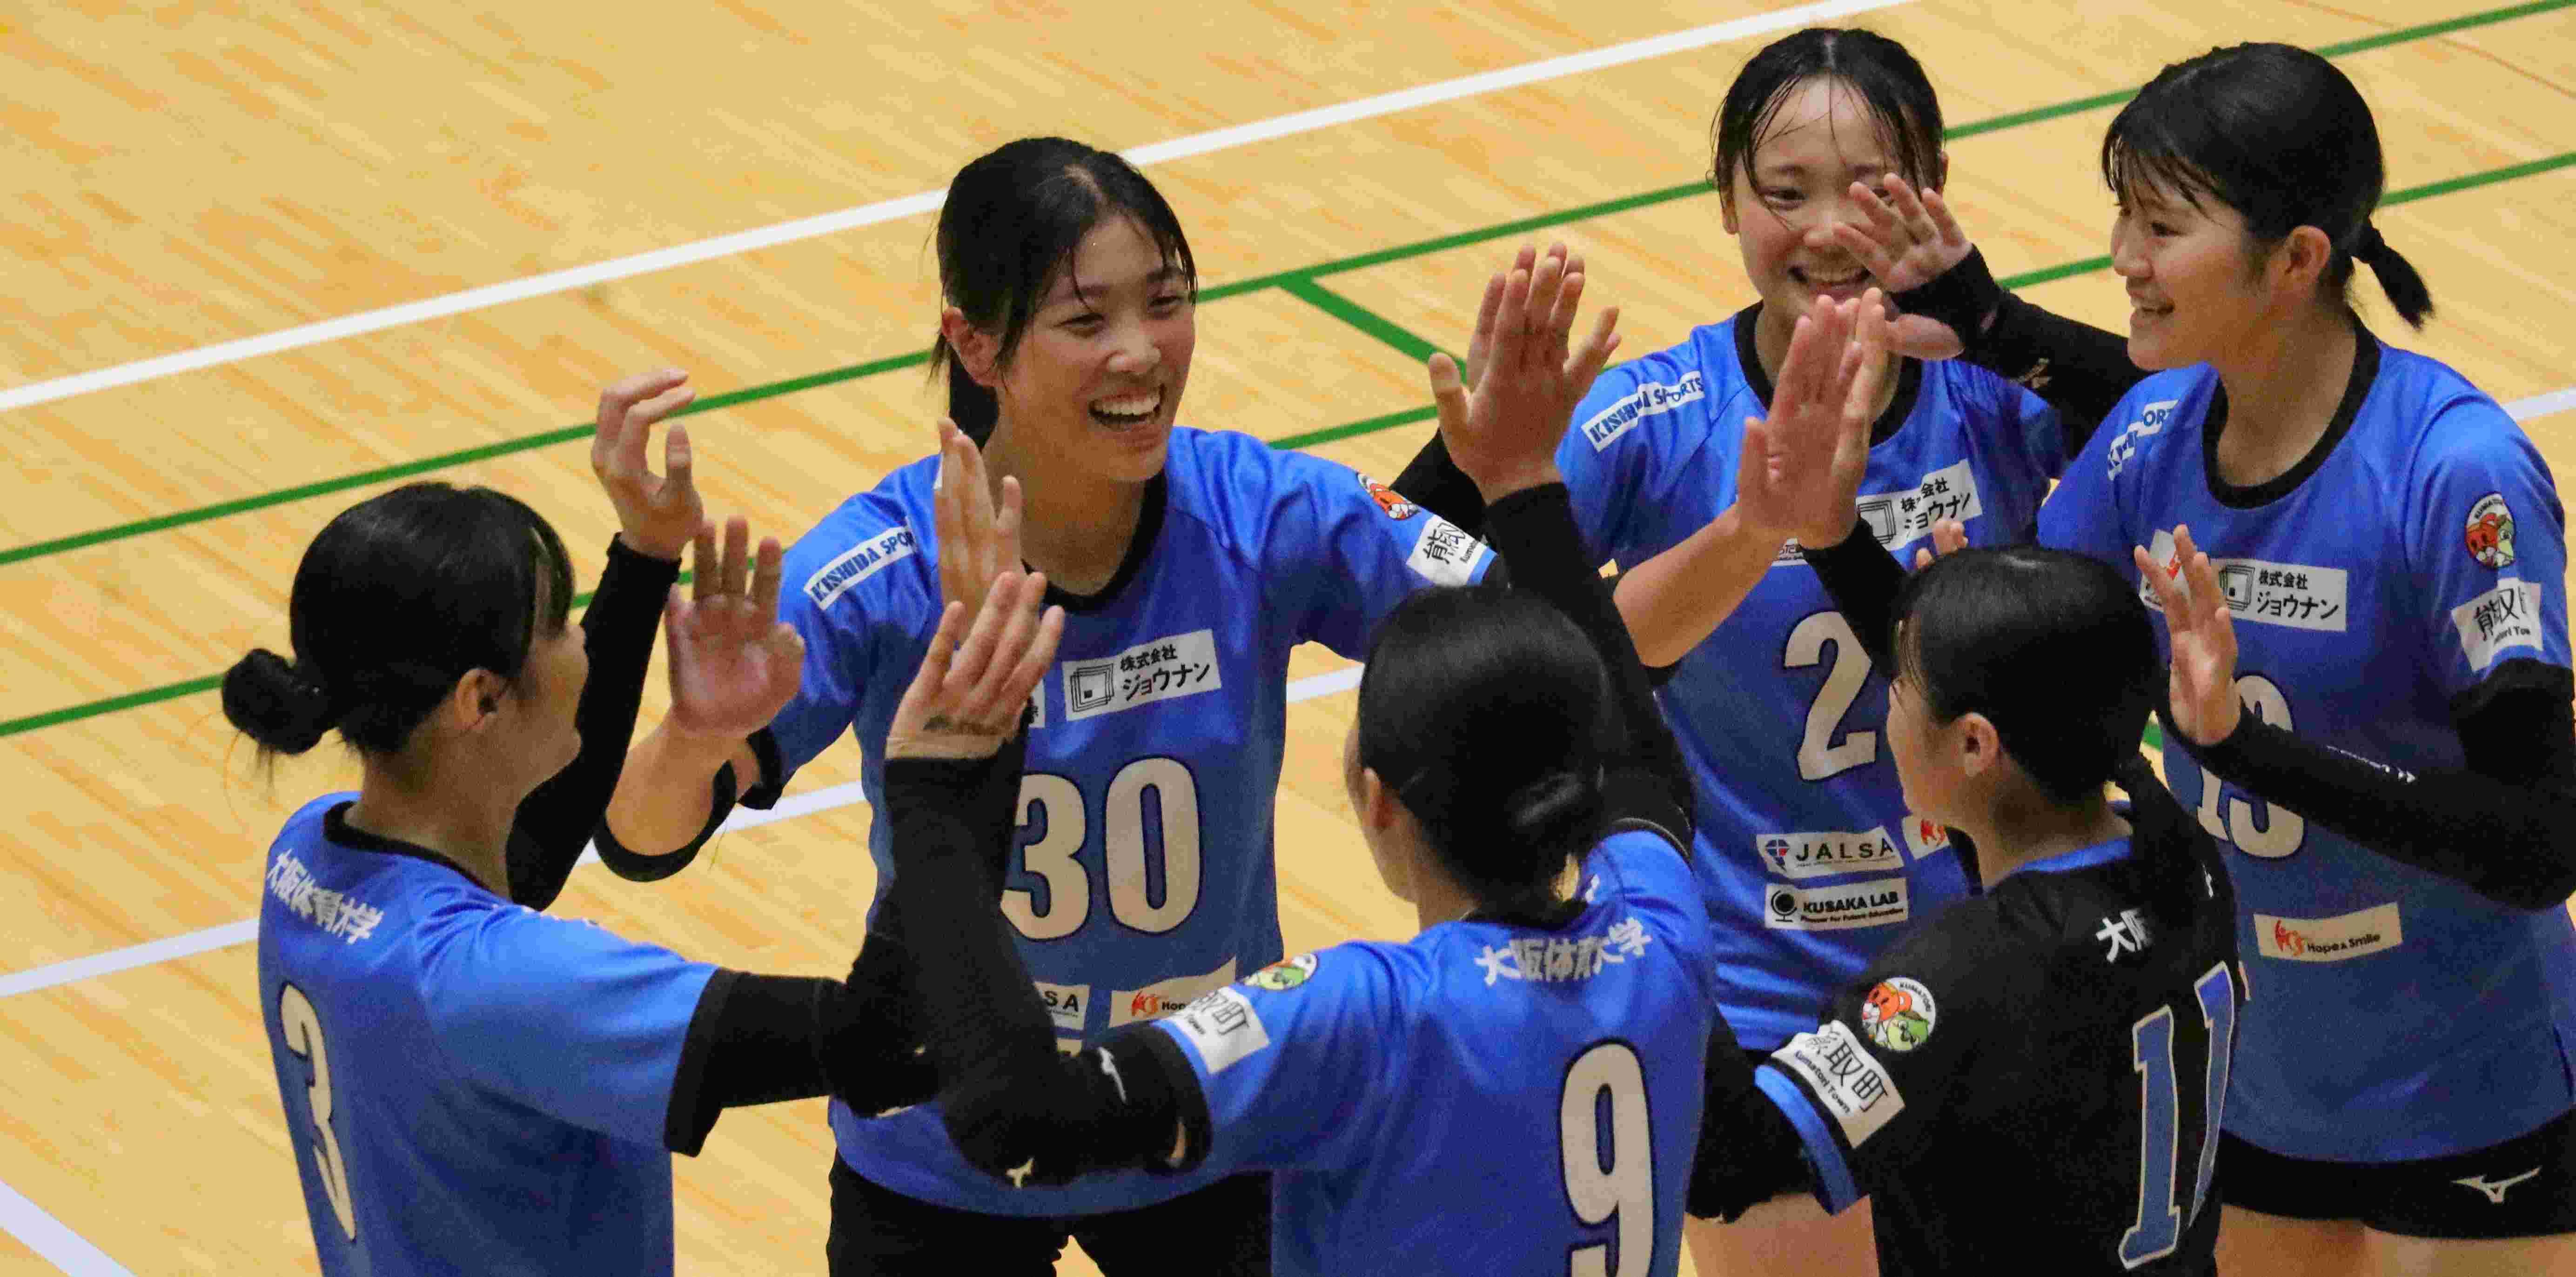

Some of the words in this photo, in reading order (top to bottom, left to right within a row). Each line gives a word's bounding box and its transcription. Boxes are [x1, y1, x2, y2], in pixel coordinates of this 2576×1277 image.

[1901, 477, 1950, 512] 株会社
[811, 547, 882, 602] KISHIDA
[2259, 568, 2309, 590] 株式会社
[2257, 591, 2339, 619] ジョウナン
[1120, 643, 1178, 672] 株式会社
[1122, 661, 1210, 702] ジョウナン
[1783, 610, 1877, 782] 2
[1000, 755, 1204, 942] 30
[1795, 837, 1894, 862] JALSA
[1803, 896, 1868, 913] KUSAKA
[1869, 891, 1899, 907] LAB
[1474, 916, 1652, 987] 大阪体育大学
[1161, 1002, 1186, 1011] Hop
[279, 980, 358, 1242] 3
[2118, 960, 2234, 1270] 11
[1557, 1036, 1657, 1277] 9
